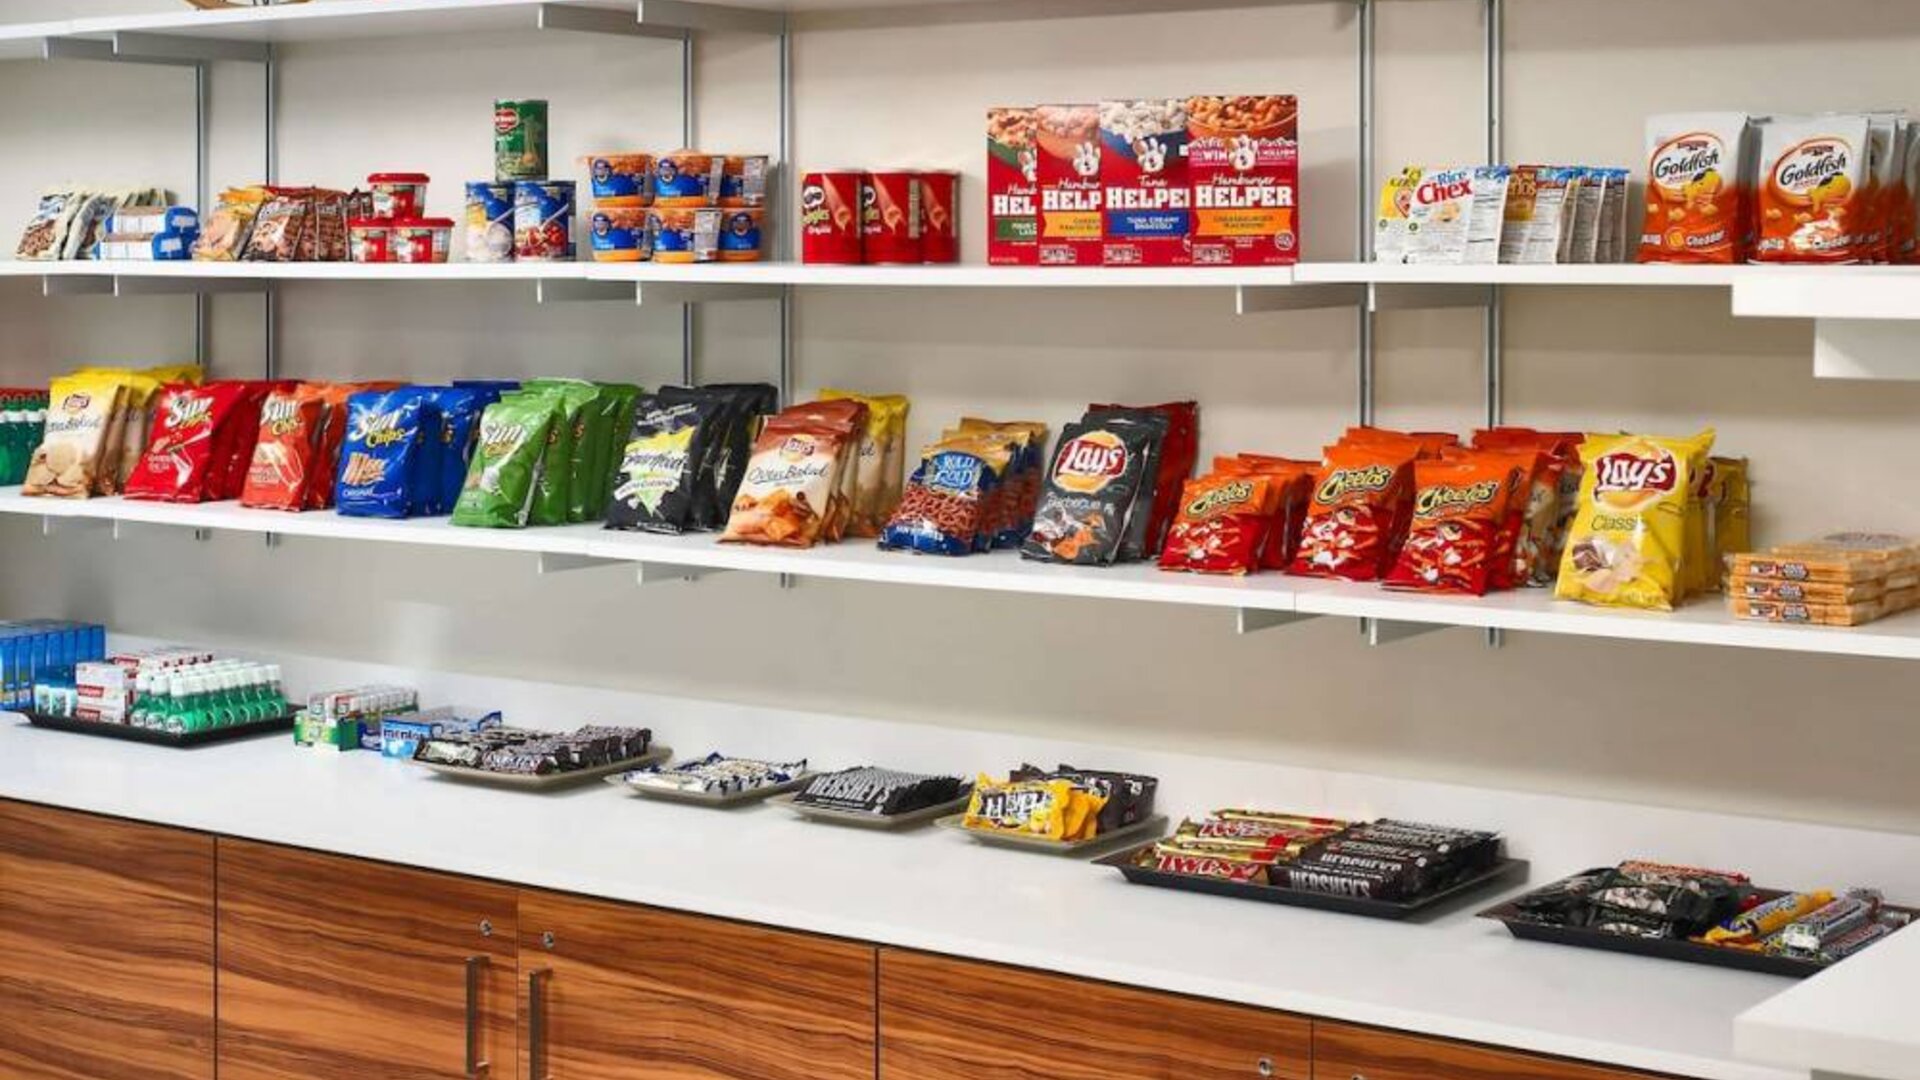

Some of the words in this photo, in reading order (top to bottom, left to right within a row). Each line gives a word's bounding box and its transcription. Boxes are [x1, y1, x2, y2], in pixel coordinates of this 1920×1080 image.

[1437, 170, 1467, 185] Rice
[1655, 148, 1719, 179] Goldfish
[1780, 153, 1846, 186] Goldfish
[1136, 174, 1168, 188] Tuna
[1211, 172, 1277, 188] Hamburger
[1417, 179, 1473, 205] Chex
[1195, 185, 1294, 208] HELPER
[1316, 466, 1391, 503] Cheetos
[1187, 483, 1253, 516] Cheetos
[1414, 481, 1499, 517] Cheetos
